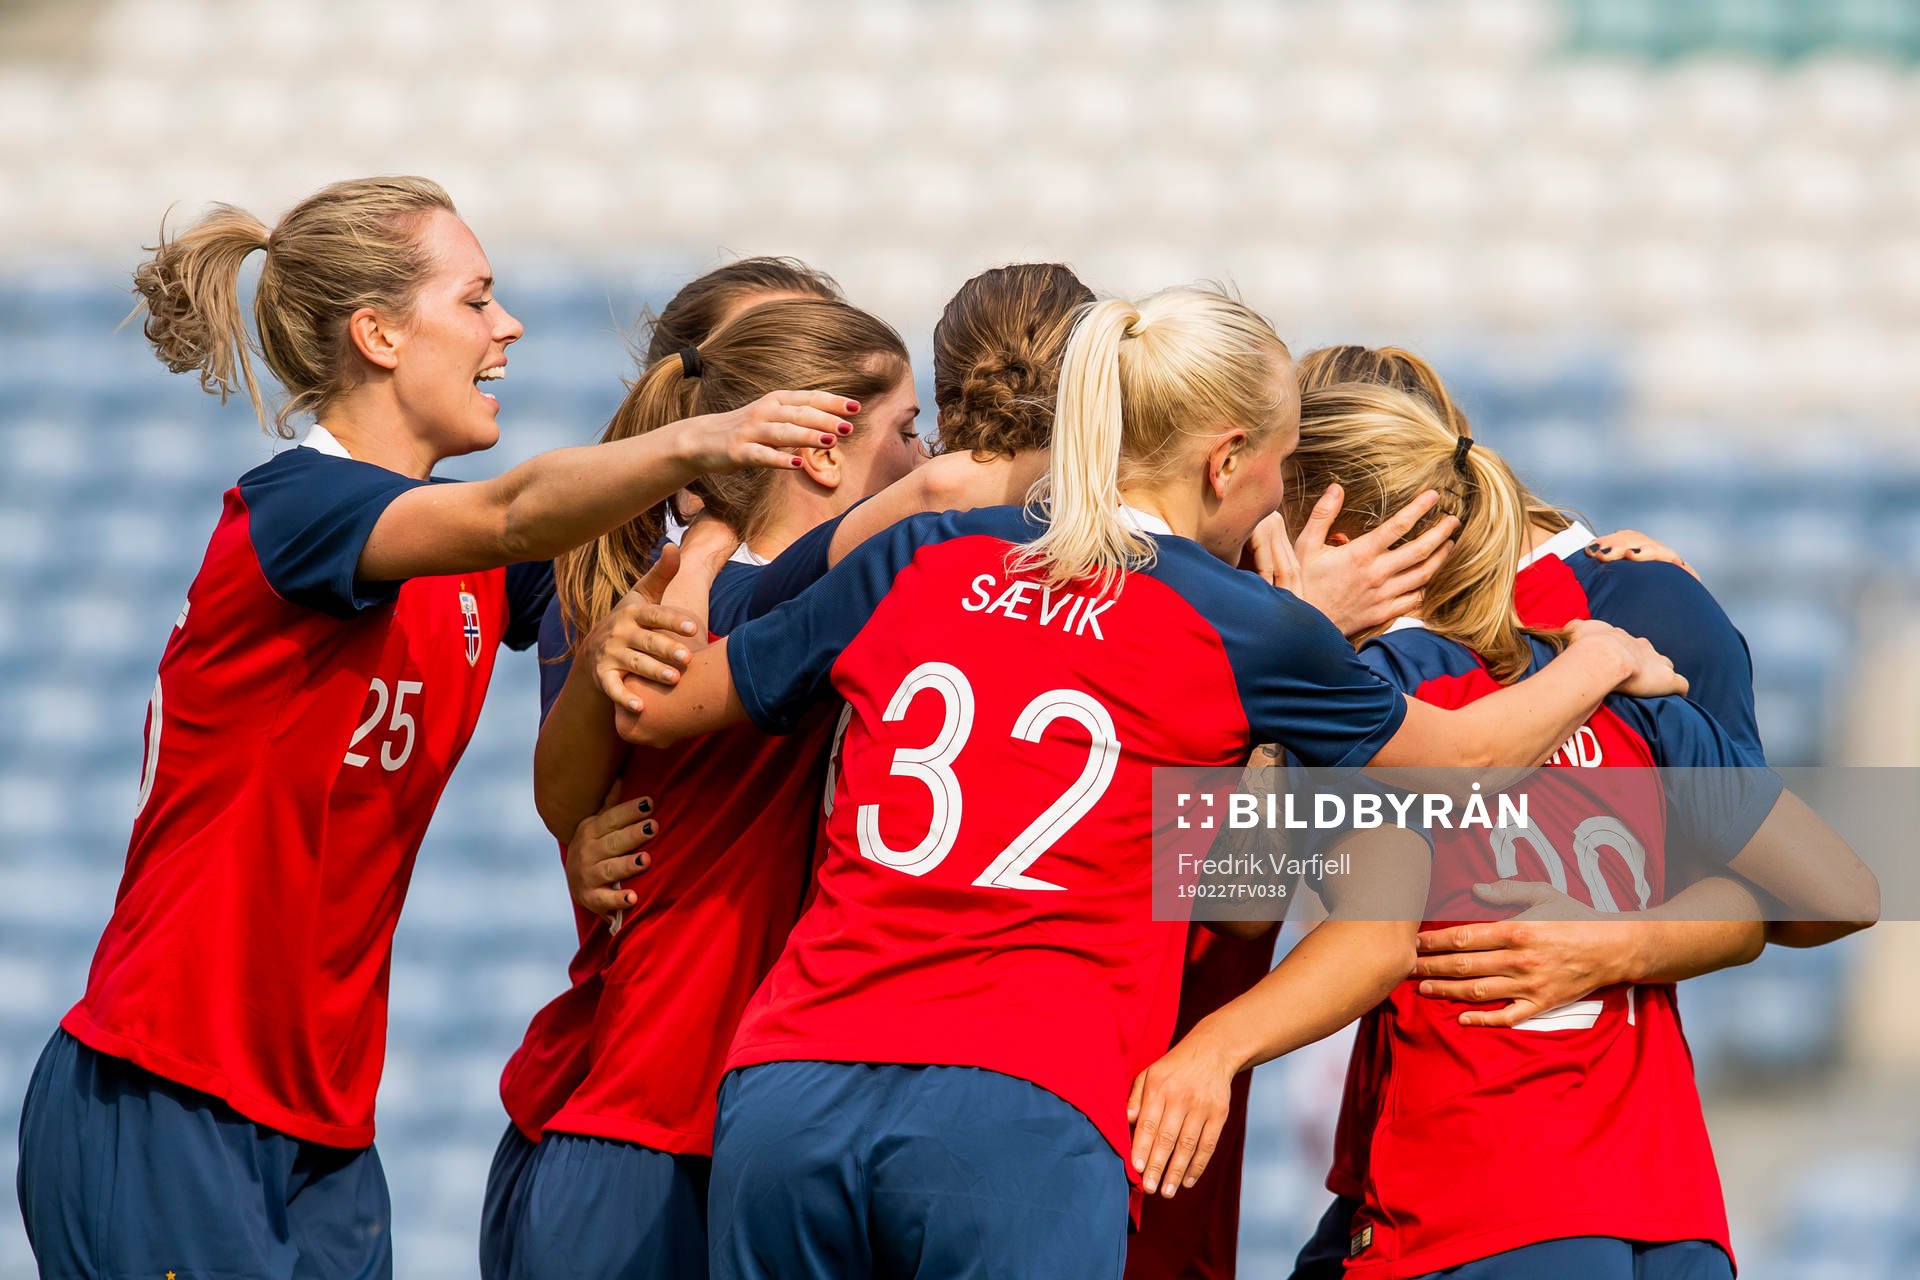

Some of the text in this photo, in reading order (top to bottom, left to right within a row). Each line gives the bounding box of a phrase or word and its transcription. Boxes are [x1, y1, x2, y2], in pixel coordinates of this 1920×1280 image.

[961, 574, 1117, 641] SÆVIK
[343, 677, 424, 771] 25
[856, 661, 1122, 891] 32
